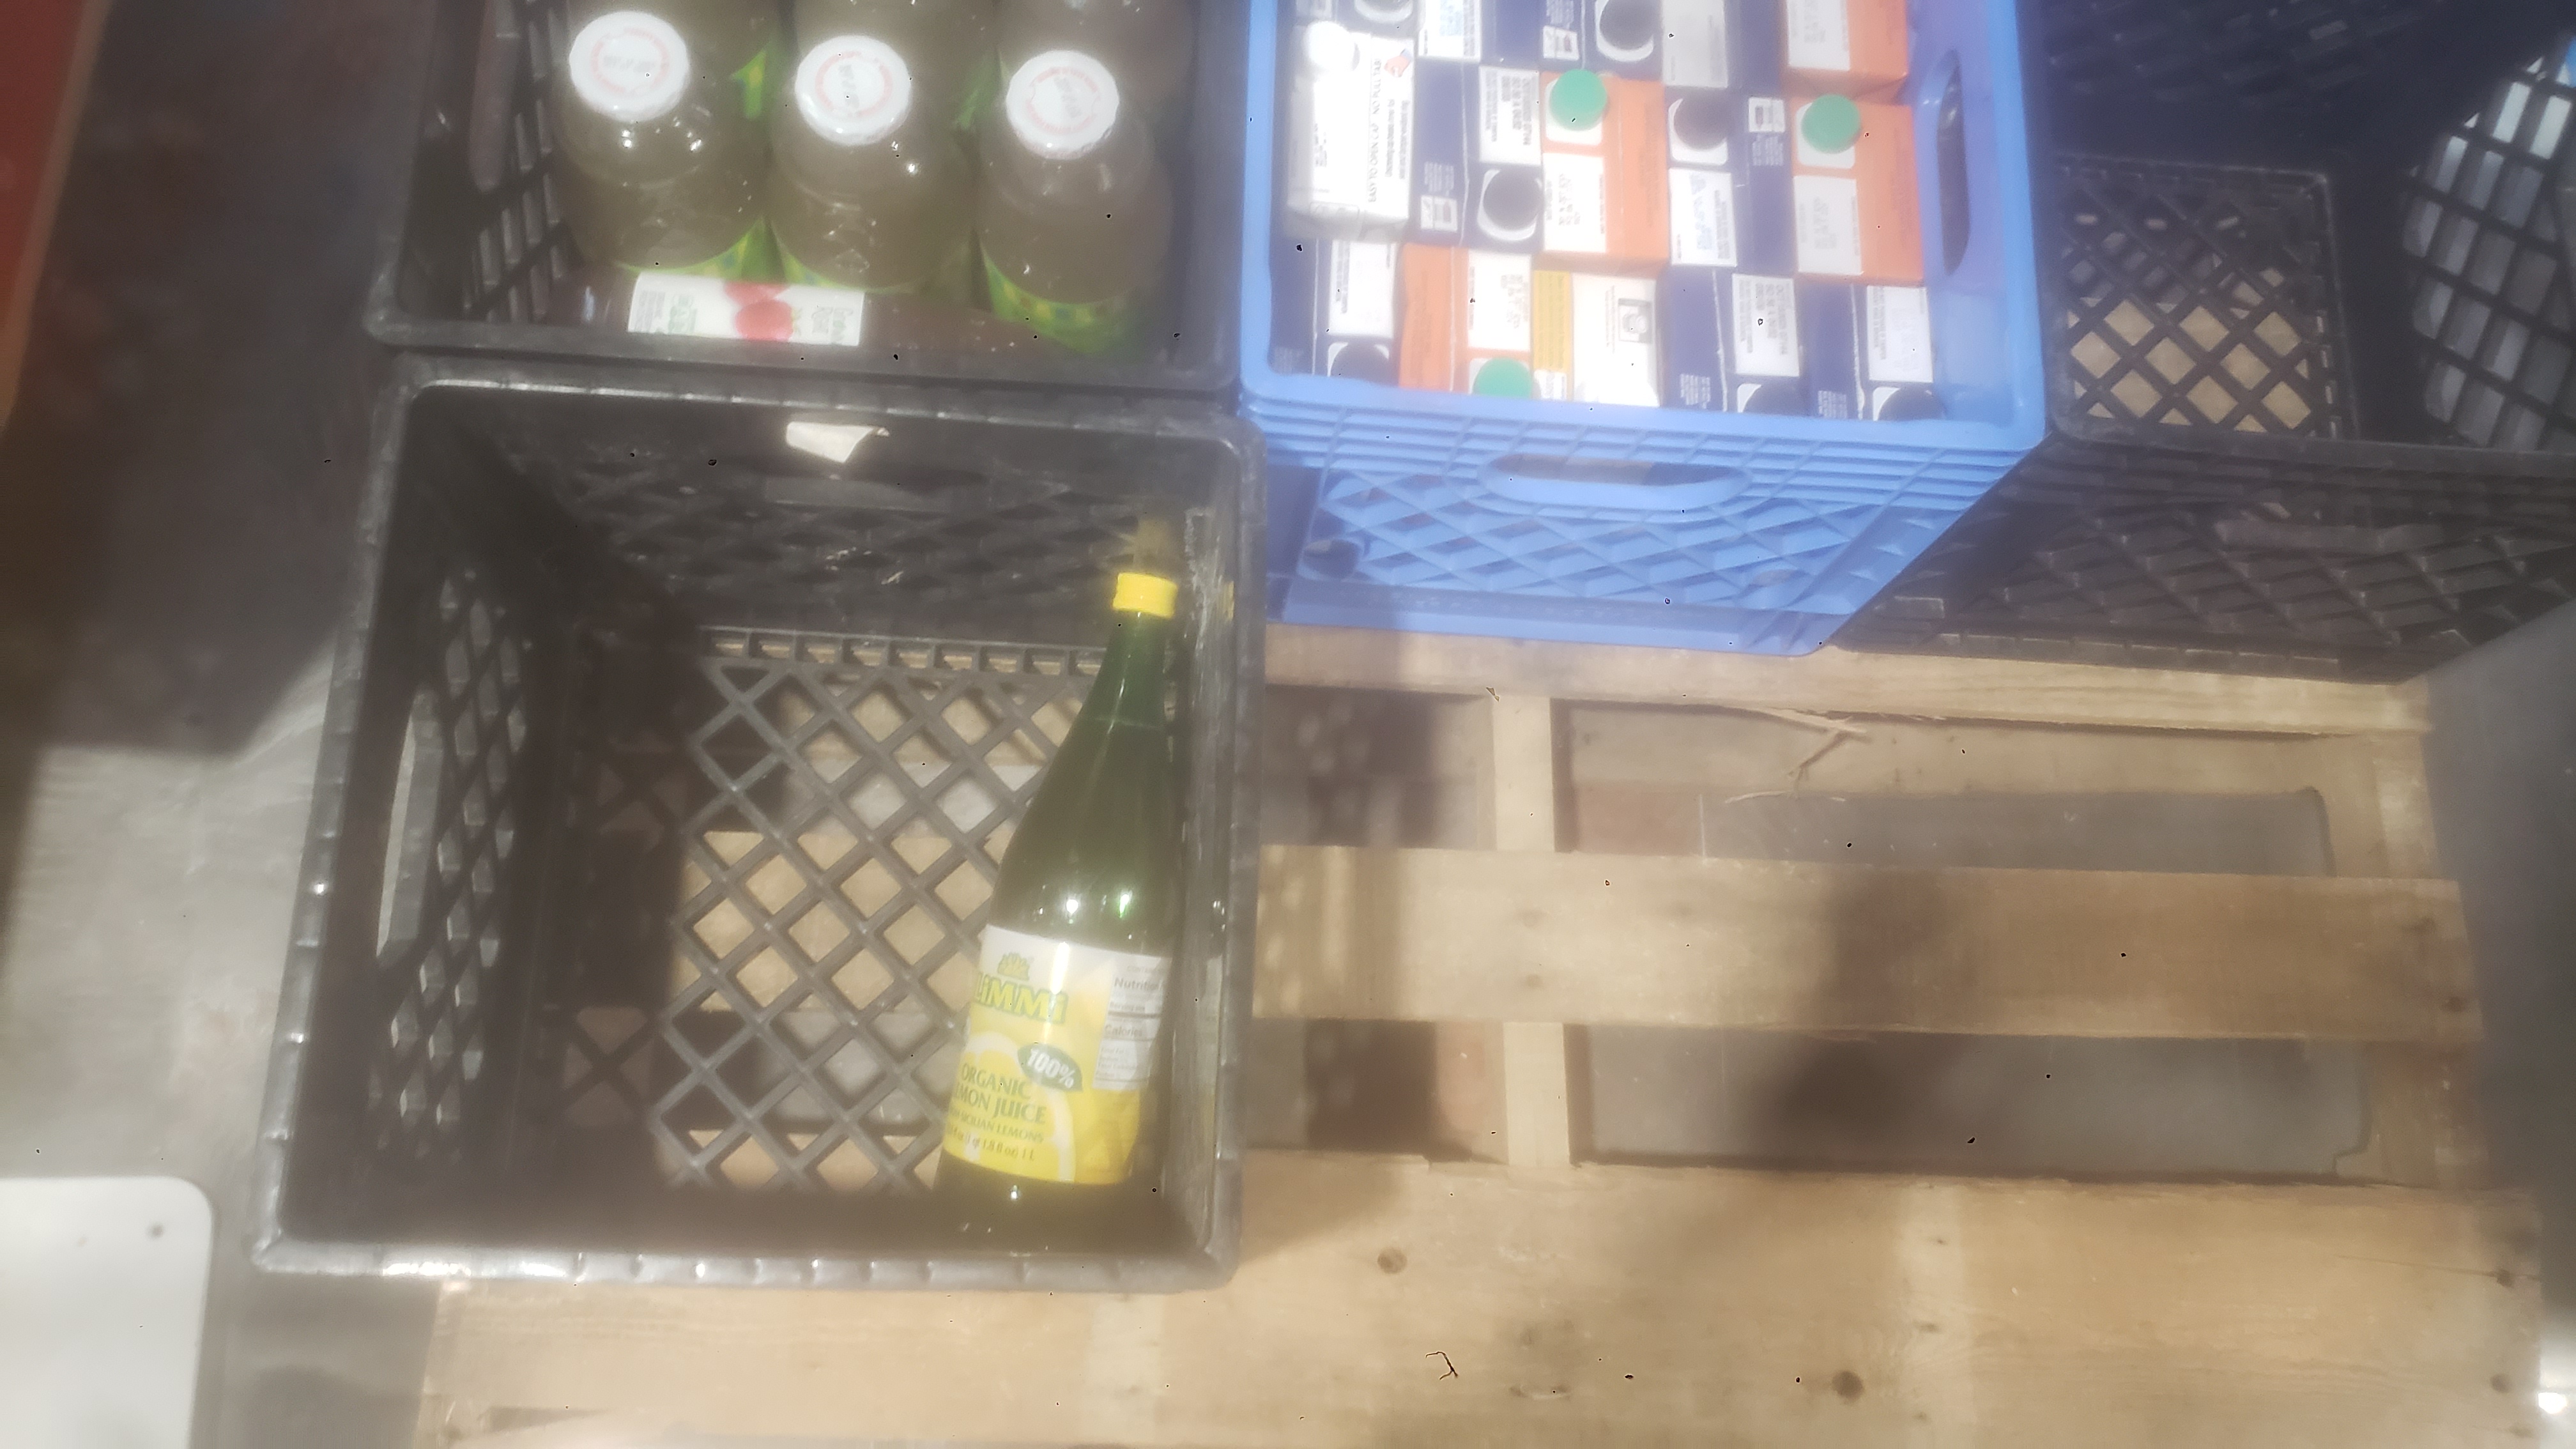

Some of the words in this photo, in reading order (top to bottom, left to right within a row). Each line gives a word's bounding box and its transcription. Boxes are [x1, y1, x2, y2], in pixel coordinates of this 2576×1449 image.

[961, 1063, 1031, 1100] ORGANIC
[1027, 1048, 1075, 1089] 100%
[992, 1097, 1048, 1124] JUICE
[997, 1123, 1045, 1143] LEMONS
